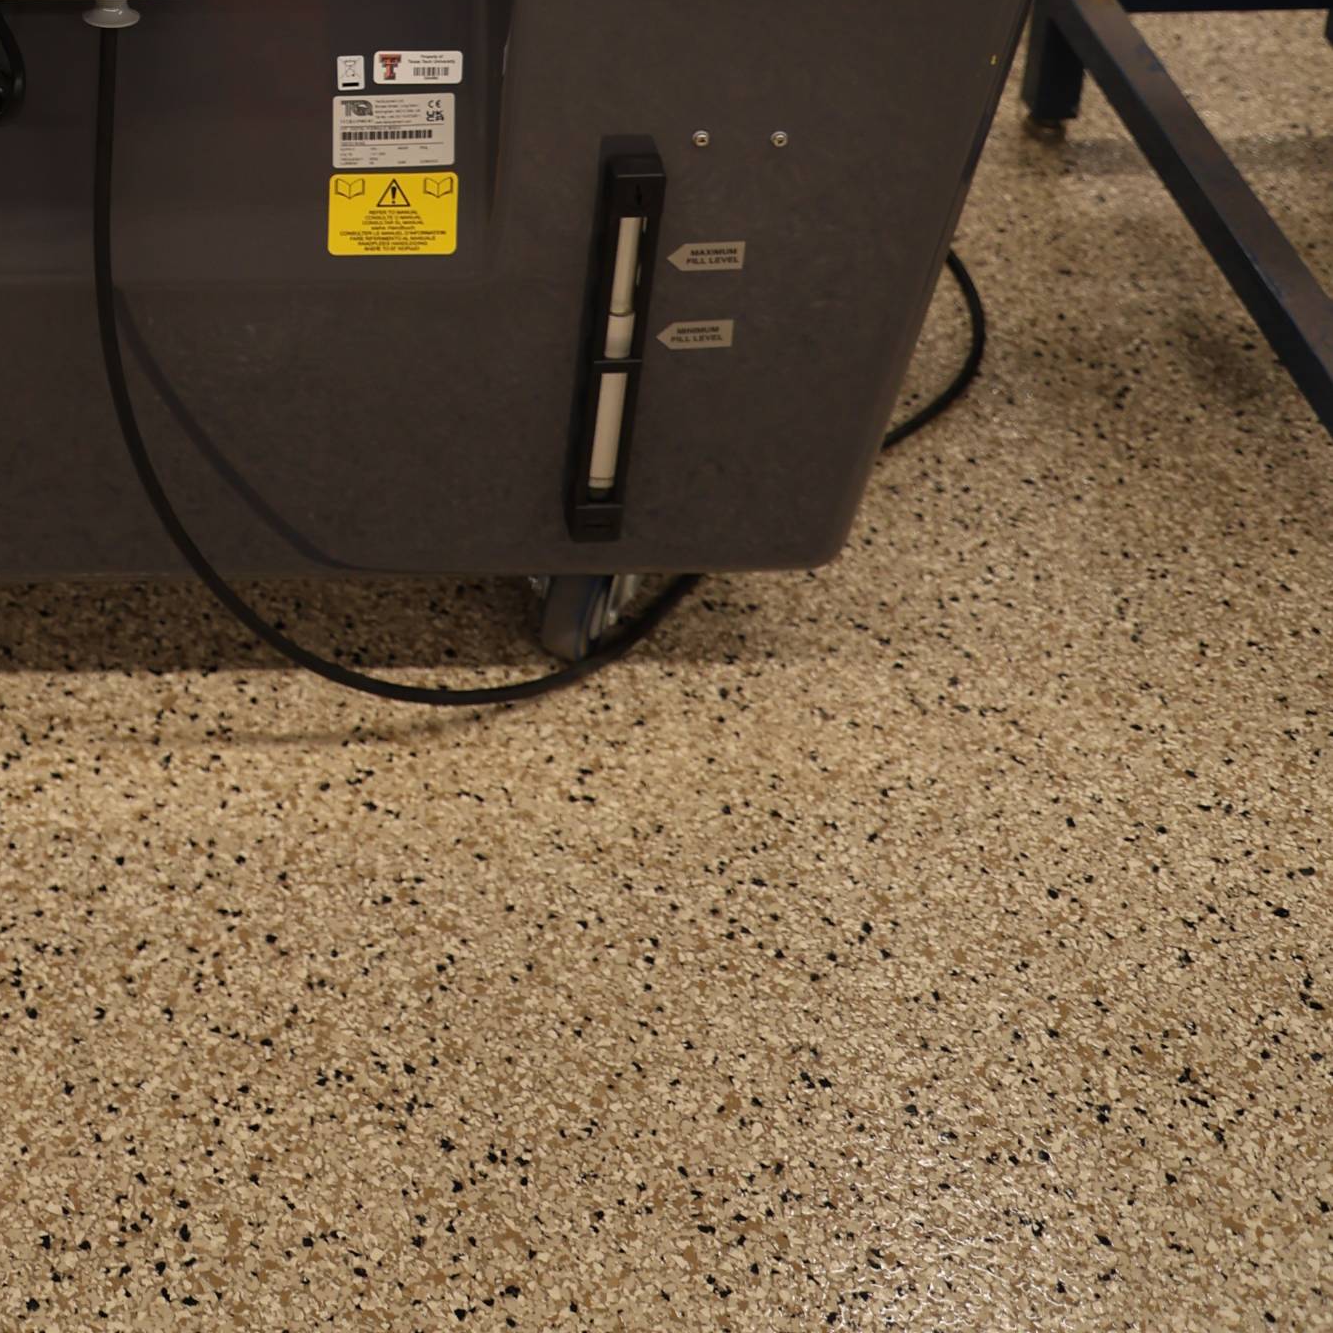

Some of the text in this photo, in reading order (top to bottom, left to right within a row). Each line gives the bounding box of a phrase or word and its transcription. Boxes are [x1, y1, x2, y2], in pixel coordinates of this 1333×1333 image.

[690, 247, 737, 256] MAXIMUM
[709, 256, 740, 264] LEVEL
[670, 334, 723, 343] FILL LEVEL
